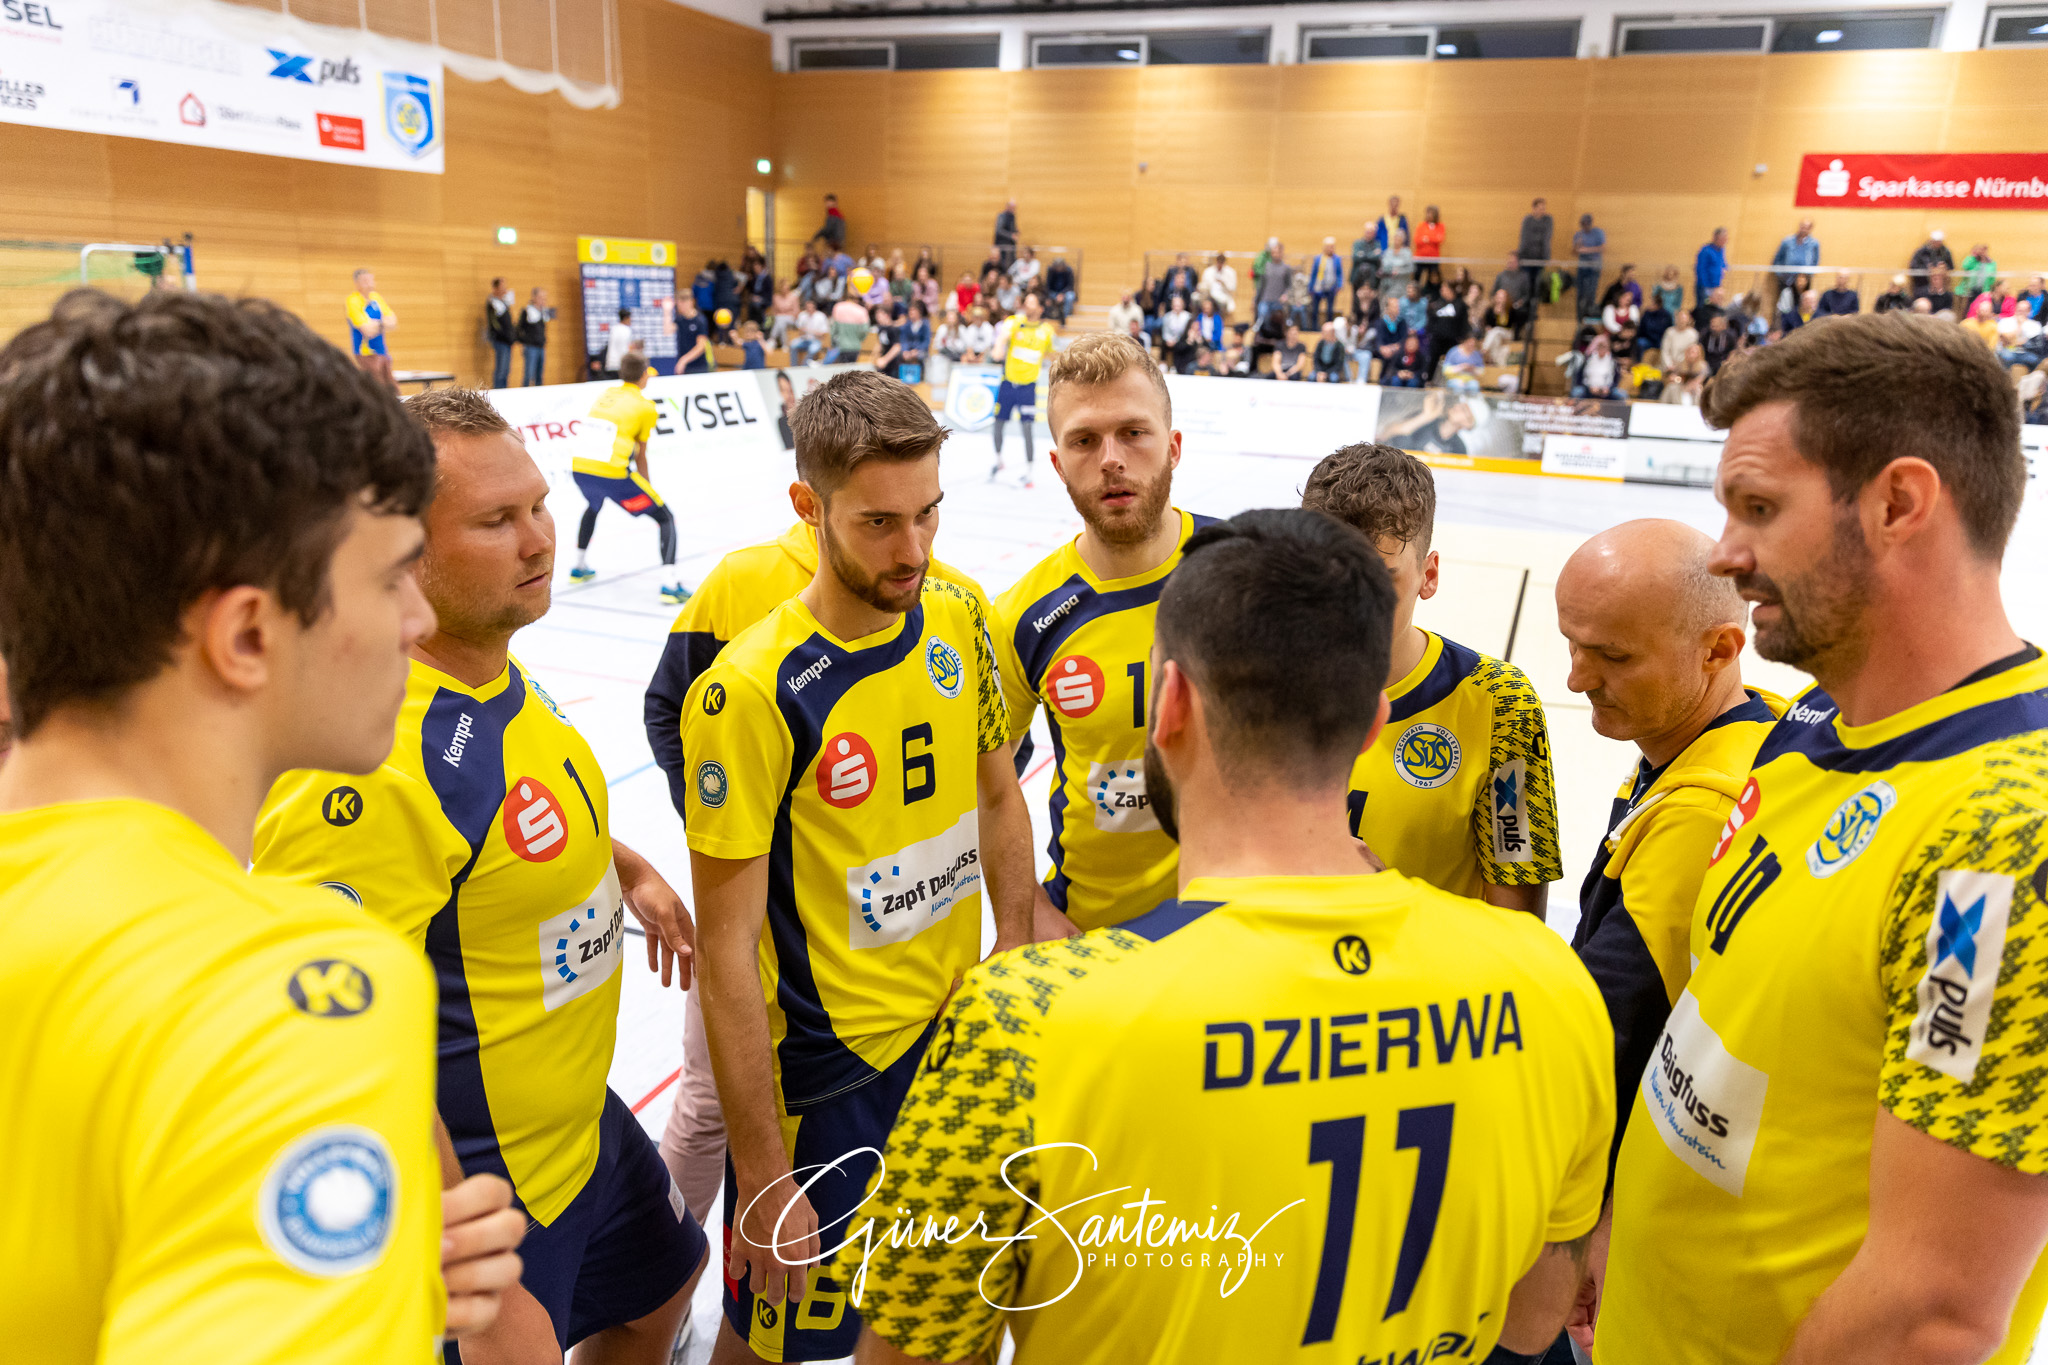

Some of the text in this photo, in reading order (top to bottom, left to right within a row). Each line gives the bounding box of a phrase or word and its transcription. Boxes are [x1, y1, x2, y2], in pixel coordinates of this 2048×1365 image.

[319, 57, 361, 86] puls
[1857, 176, 1971, 201] Sparkasse
[1033, 594, 1080, 633] Kempa
[787, 655, 833, 695] Kempa
[443, 713, 474, 768] Kempa
[902, 721, 936, 806] 6
[563, 758, 599, 838] 1
[1115, 791, 1150, 810] Zap
[1415, 779, 1433, 787] 1967
[1497, 815, 1526, 852] puls
[882, 848, 978, 915] Zapf Daiguss
[1706, 834, 1782, 956] 10
[578, 918, 614, 964] Zapf
[1202, 991, 1524, 1091] DZIERWA
[1928, 974, 1972, 1057] puls
[1661, 1032, 1729, 1138] Daigfuss
[1300, 1102, 1456, 1348] 11
[795, 1264, 847, 1331] 6
